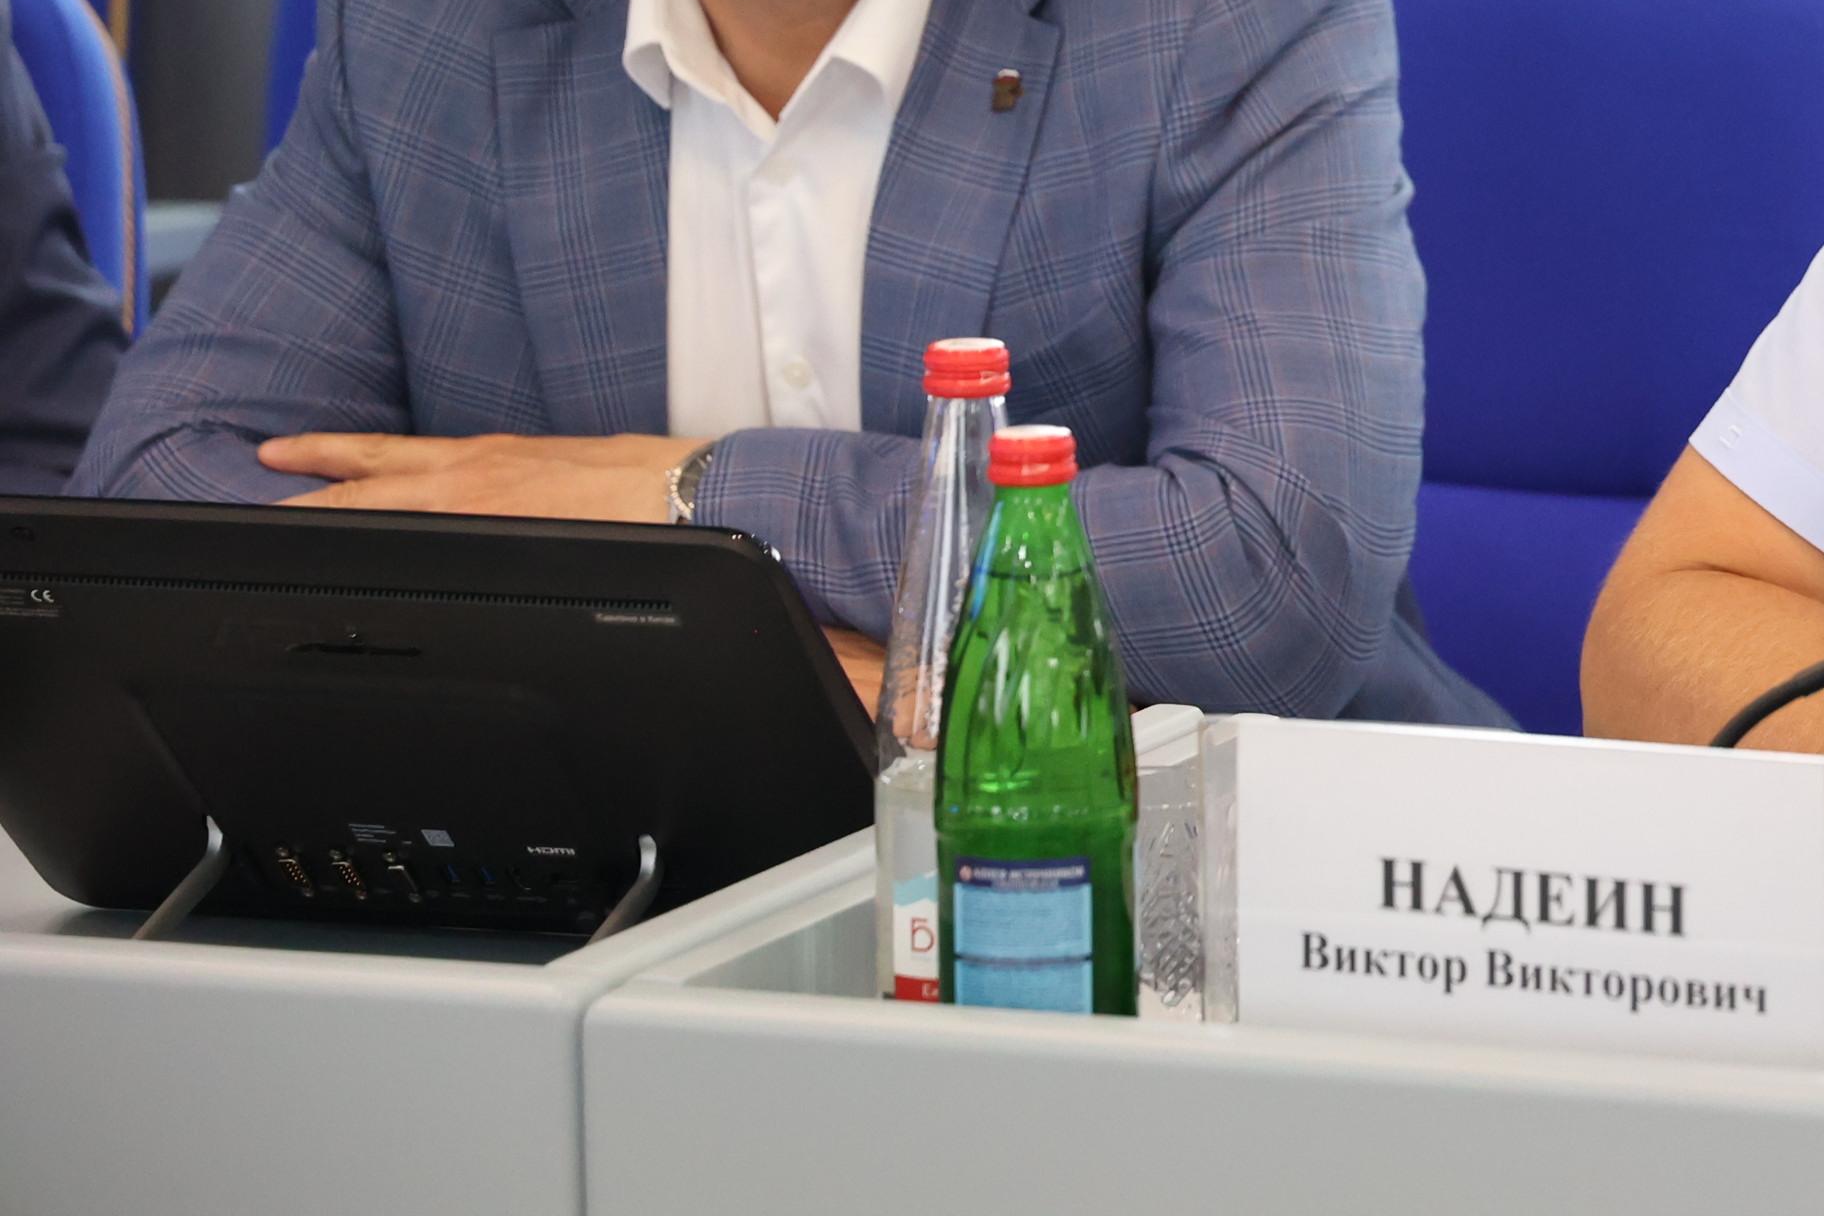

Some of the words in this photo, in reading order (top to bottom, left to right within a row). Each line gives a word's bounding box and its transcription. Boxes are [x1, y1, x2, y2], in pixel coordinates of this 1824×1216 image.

[1379, 856, 1686, 936] НАДЕИН
[1302, 931, 1467, 994] Виктор
[1485, 948, 1768, 1014] Викторович
